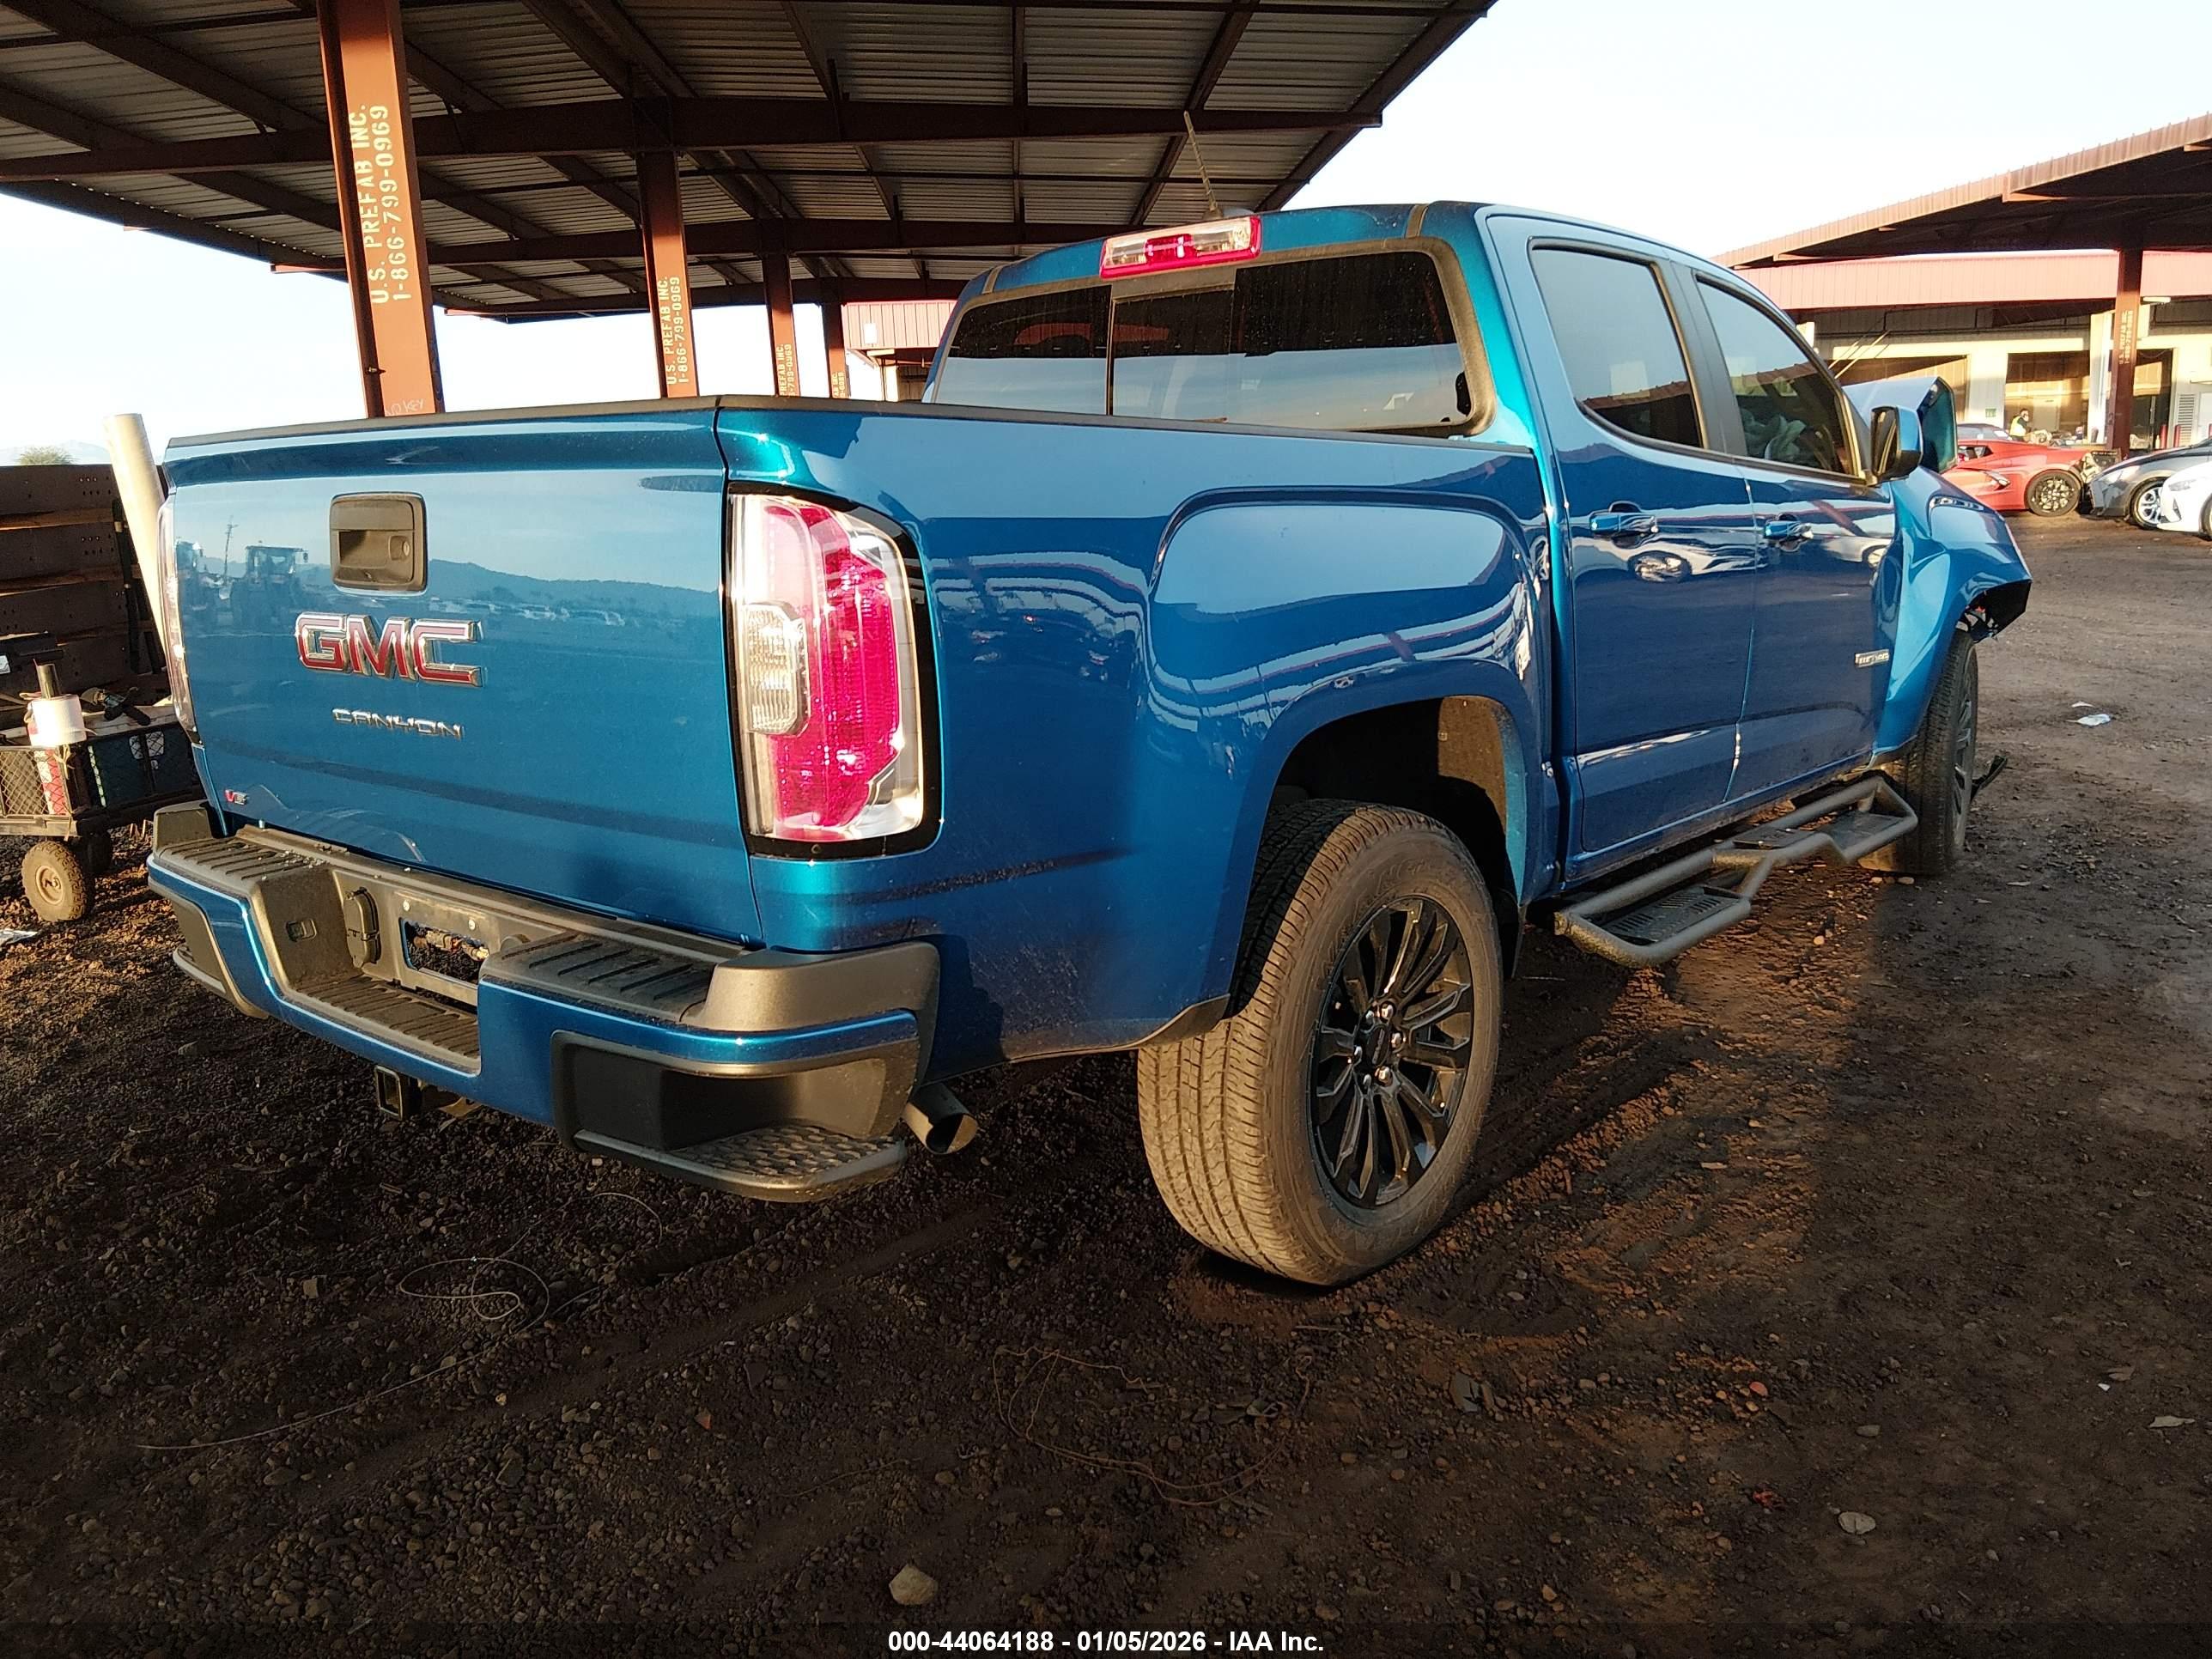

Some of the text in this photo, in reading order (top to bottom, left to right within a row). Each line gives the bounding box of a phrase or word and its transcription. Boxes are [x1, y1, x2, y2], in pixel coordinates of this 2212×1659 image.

[349, 104, 389, 304] U.S. PREFAB INC.
[369, 105, 412, 301] 1-866-799-0969
[658, 276, 678, 385] U.S. PREFAB INC.
[670, 276, 690, 384] 1-866-799-0969
[295, 611, 483, 687] GMC
[332, 708, 464, 739] CANYON
